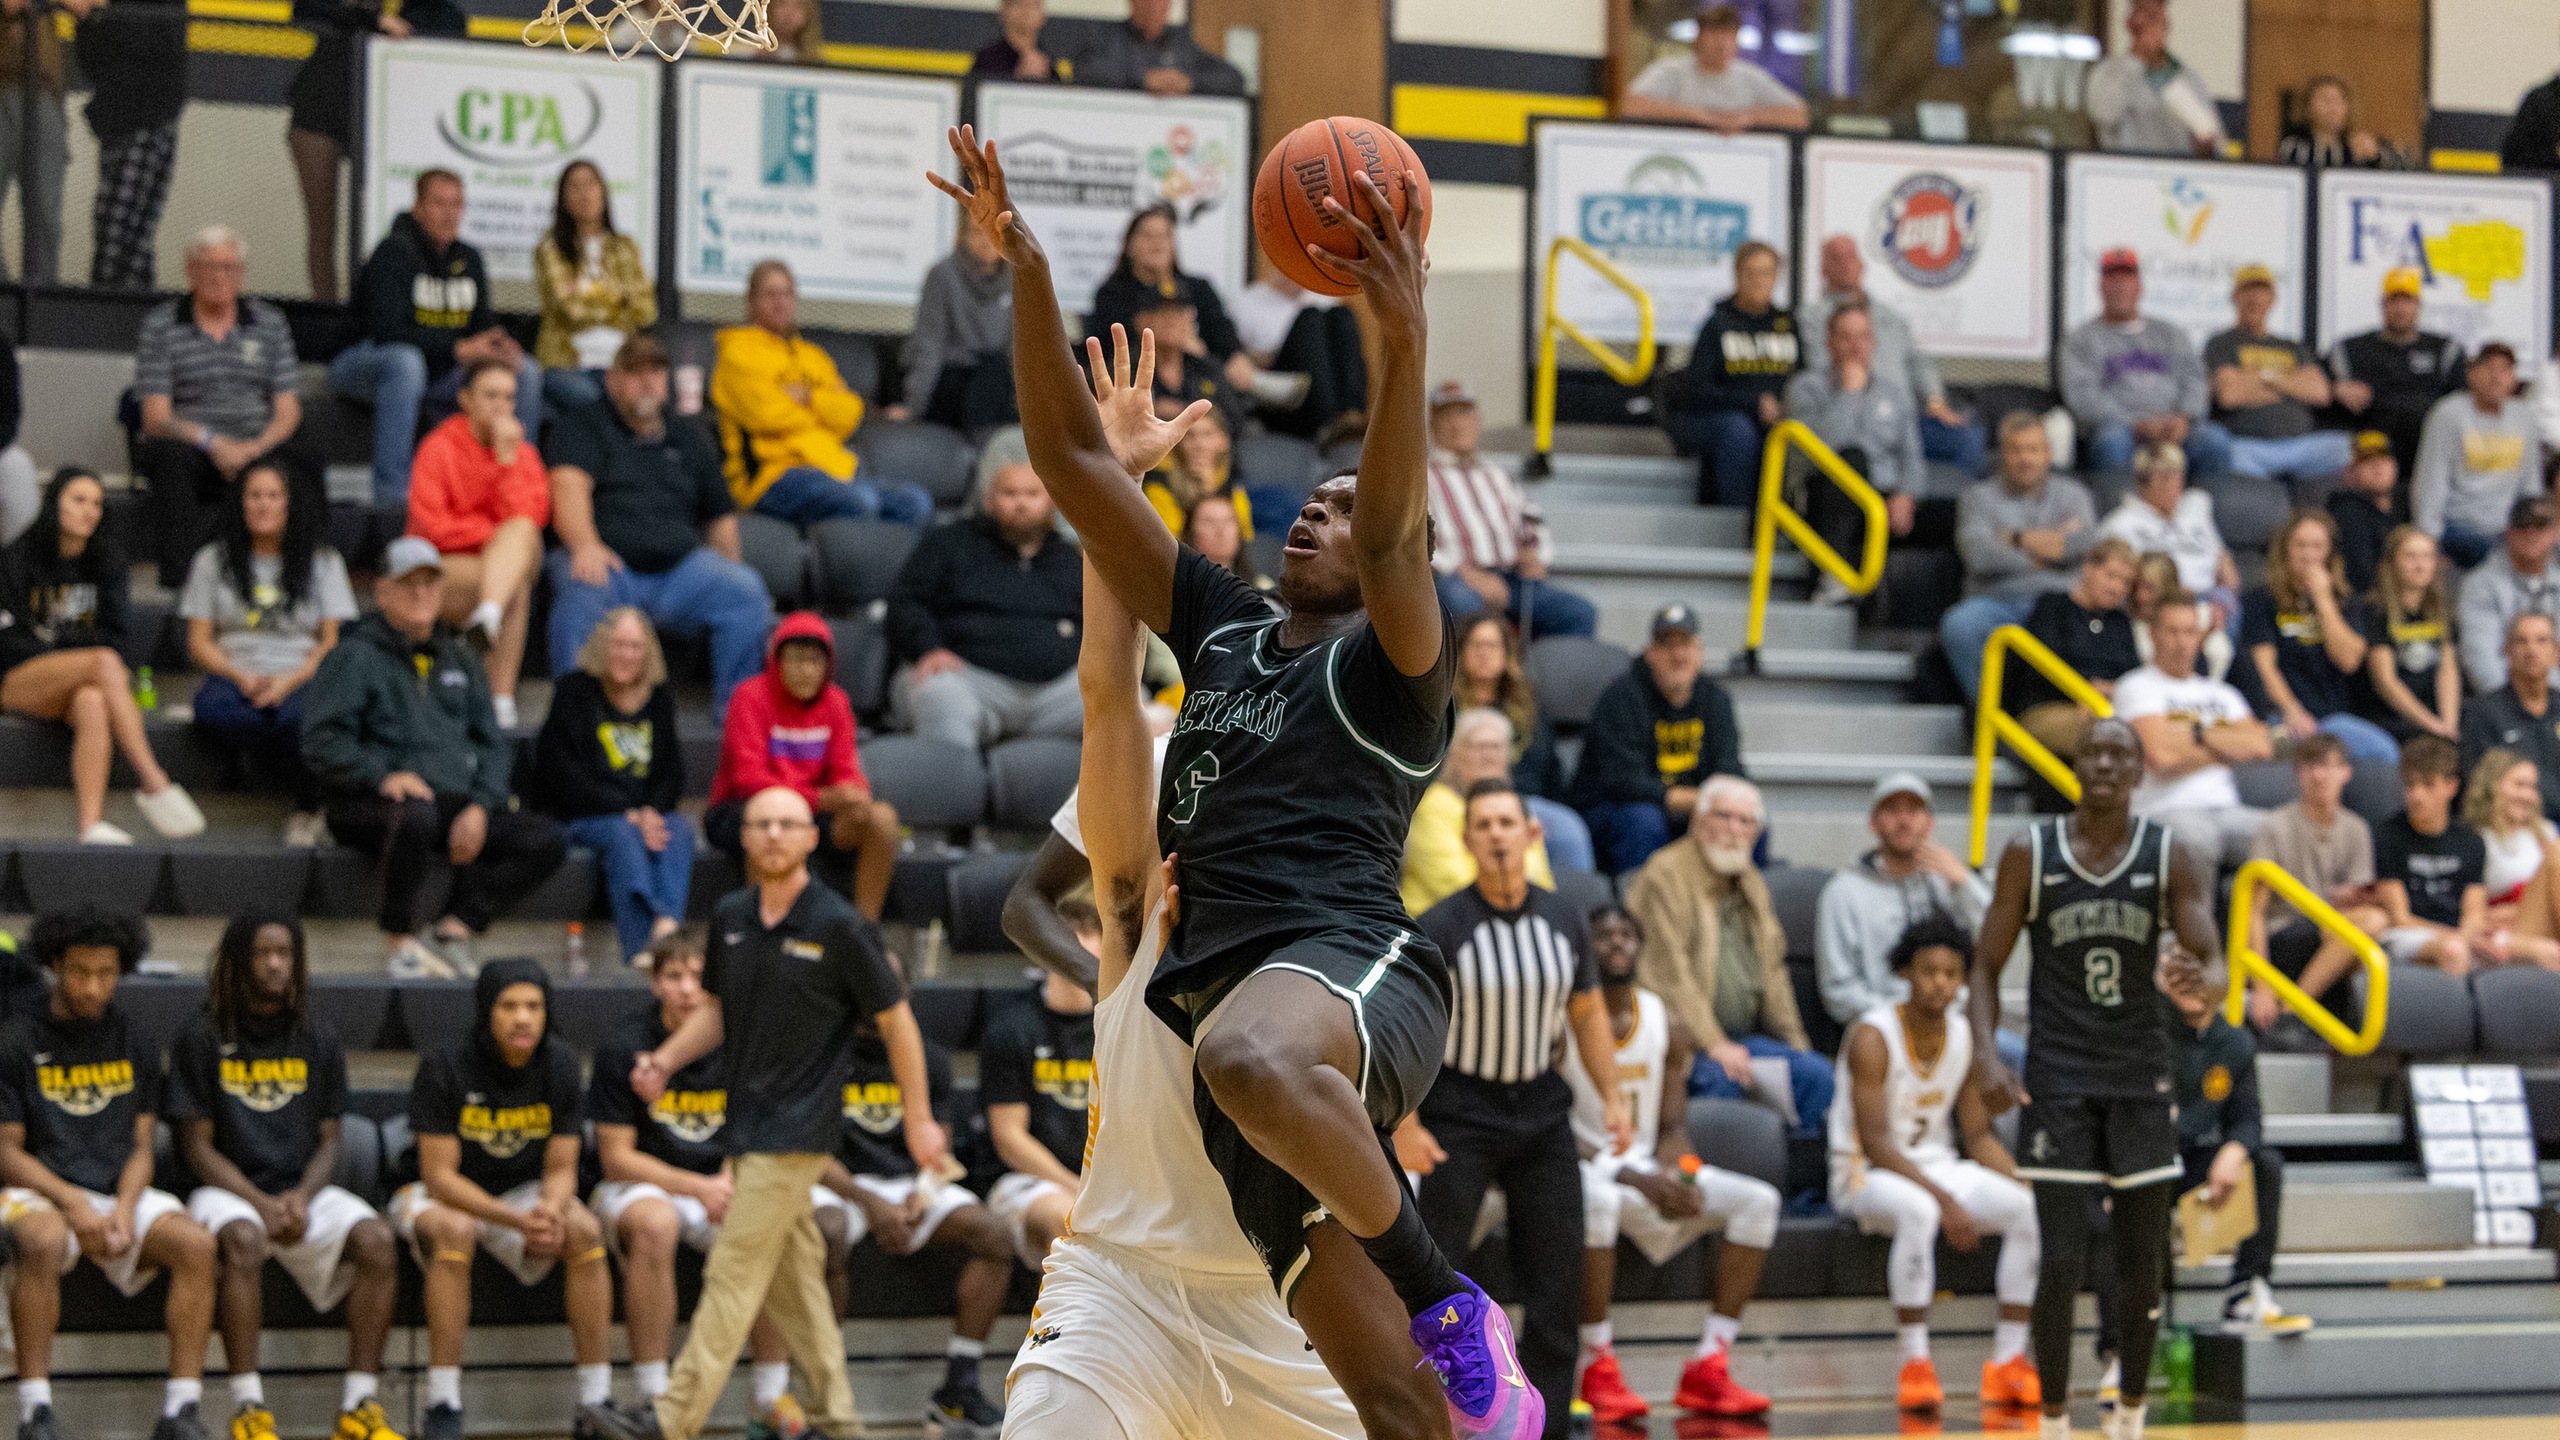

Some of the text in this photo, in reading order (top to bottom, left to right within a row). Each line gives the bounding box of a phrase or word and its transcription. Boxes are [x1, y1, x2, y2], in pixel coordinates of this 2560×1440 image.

[457, 85, 568, 153] CPA
[1587, 198, 1740, 247] Geisler
[2084, 947, 2123, 1006] 2
